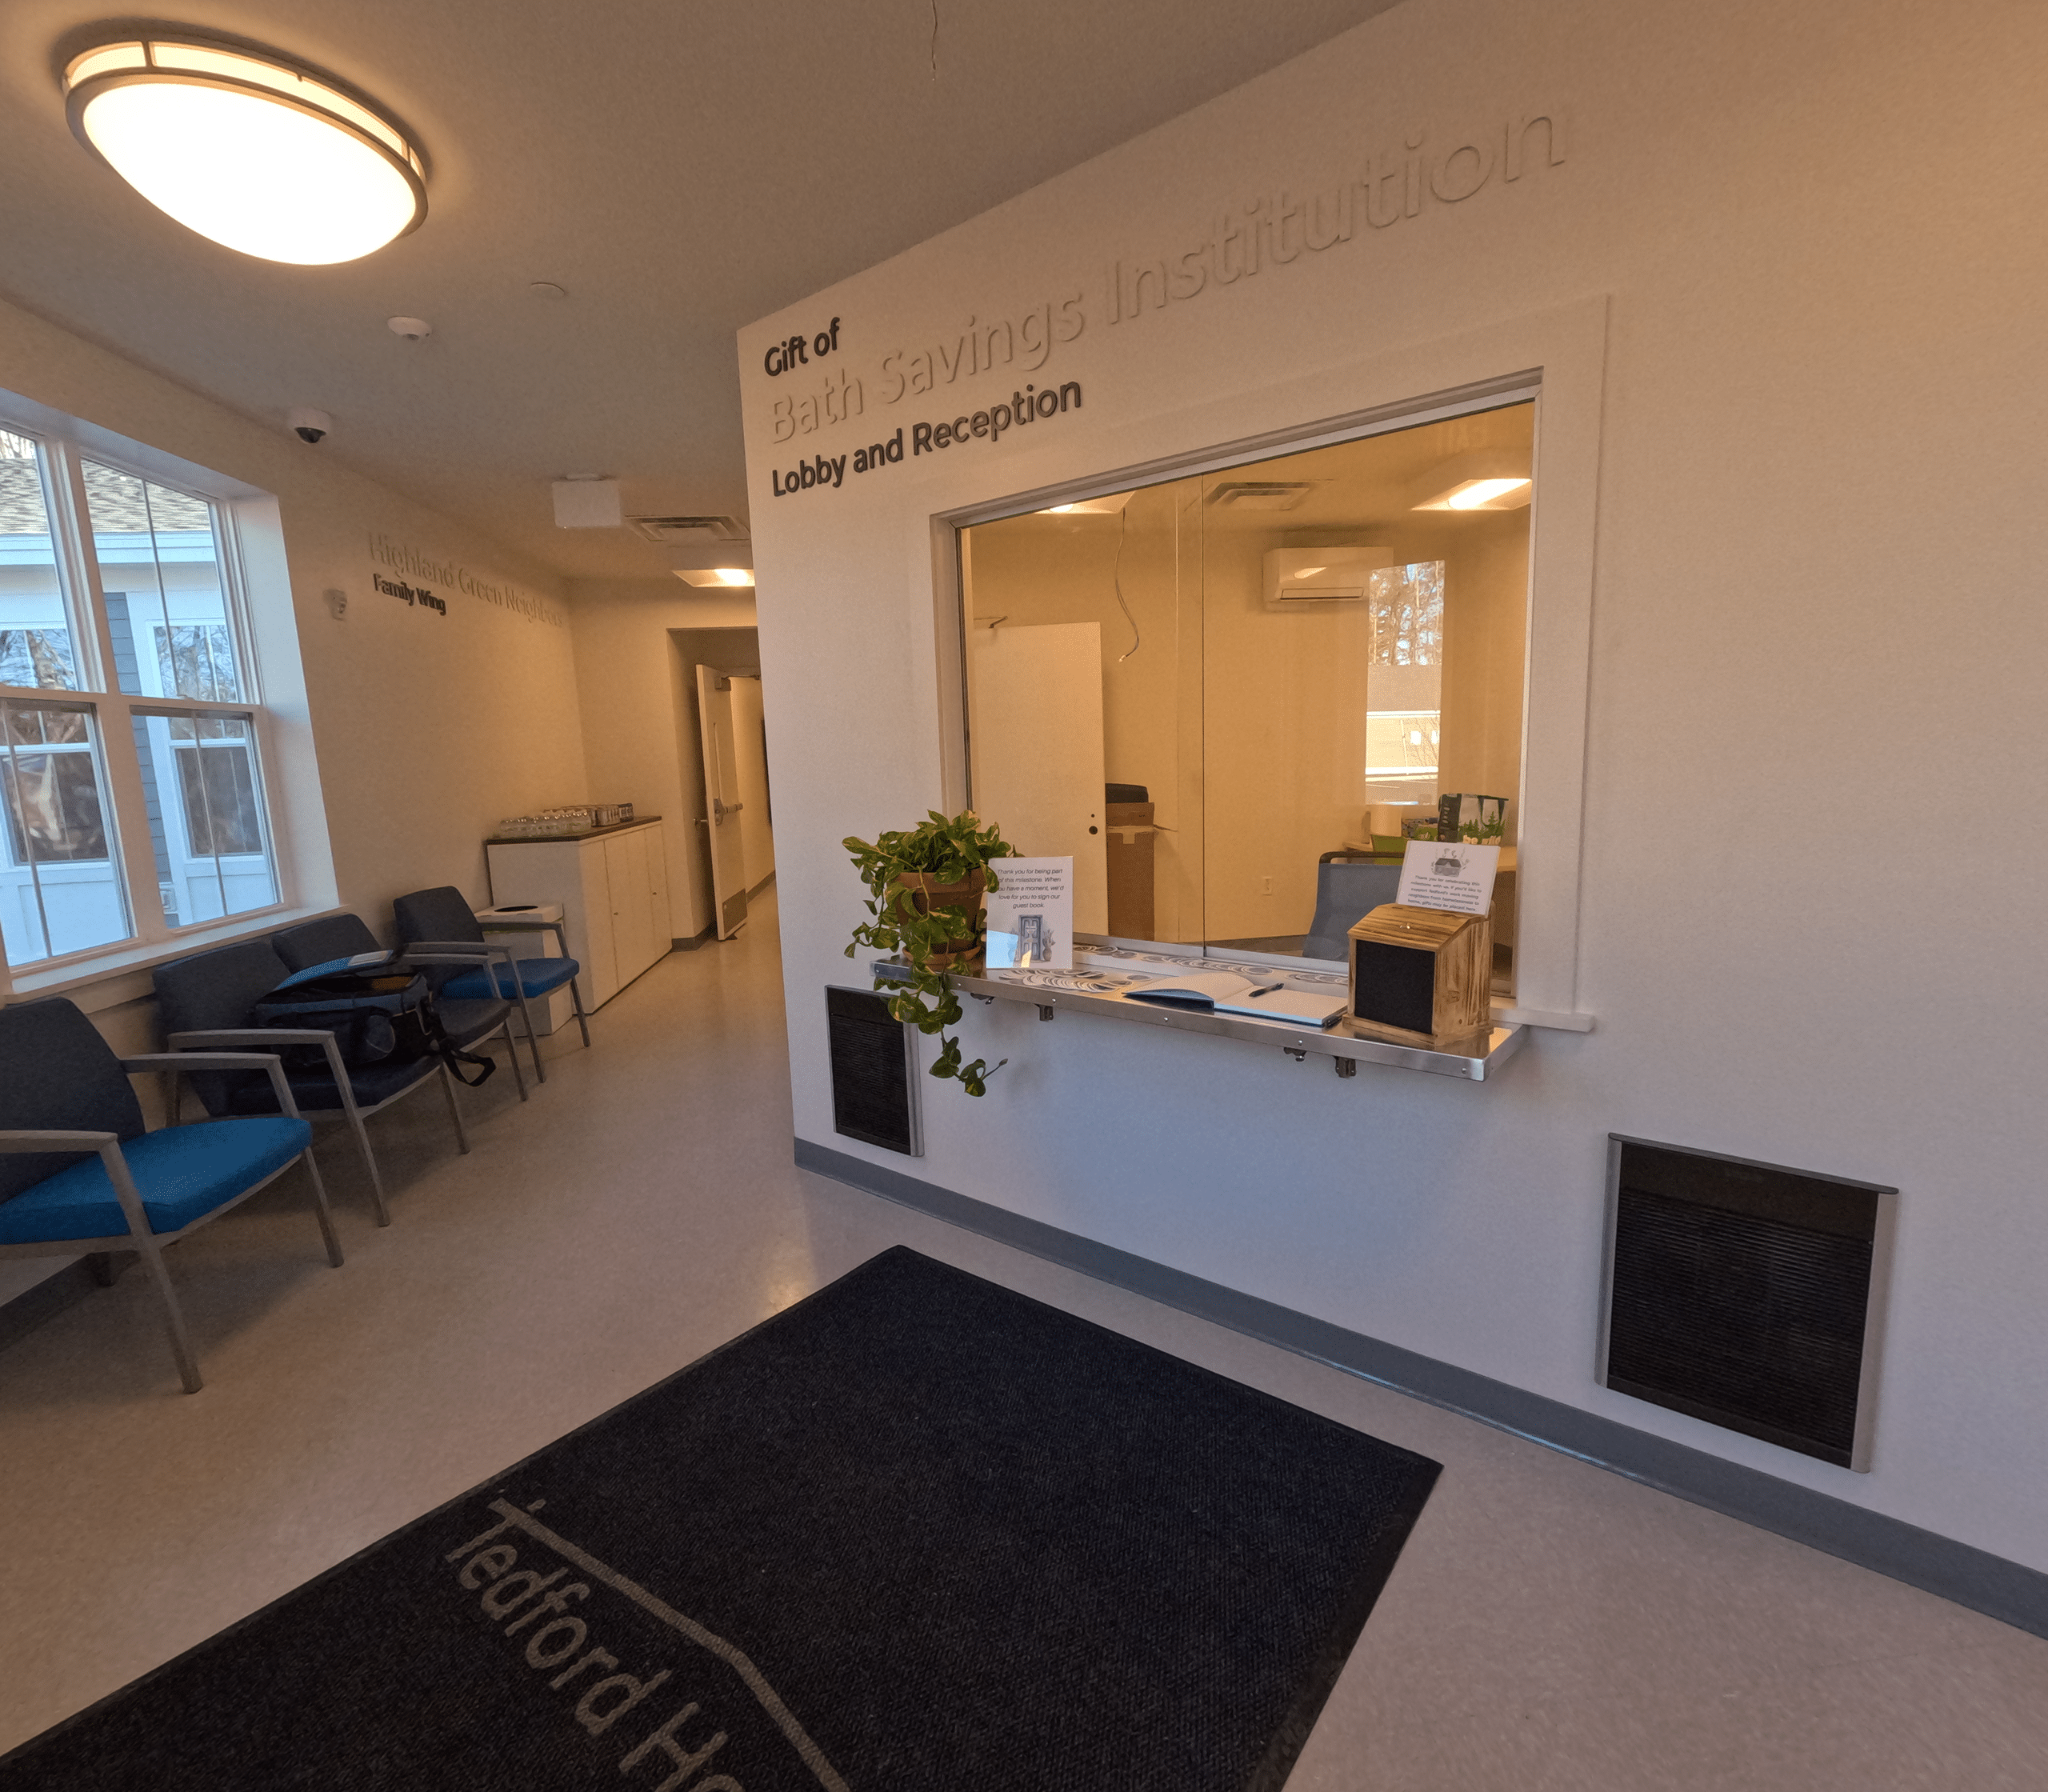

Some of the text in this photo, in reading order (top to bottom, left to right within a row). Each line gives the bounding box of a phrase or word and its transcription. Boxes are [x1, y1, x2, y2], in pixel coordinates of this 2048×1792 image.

[772, 110, 1568, 444] Bath Savings Institution
[764, 317, 840, 376] Gift of
[772, 381, 1082, 498] Lobby and Reception
[368, 531, 455, 589] Highland
[458, 567, 502, 606] Green
[373, 573, 446, 616] Family Wing
[445, 1497, 747, 1792] Tedford H
